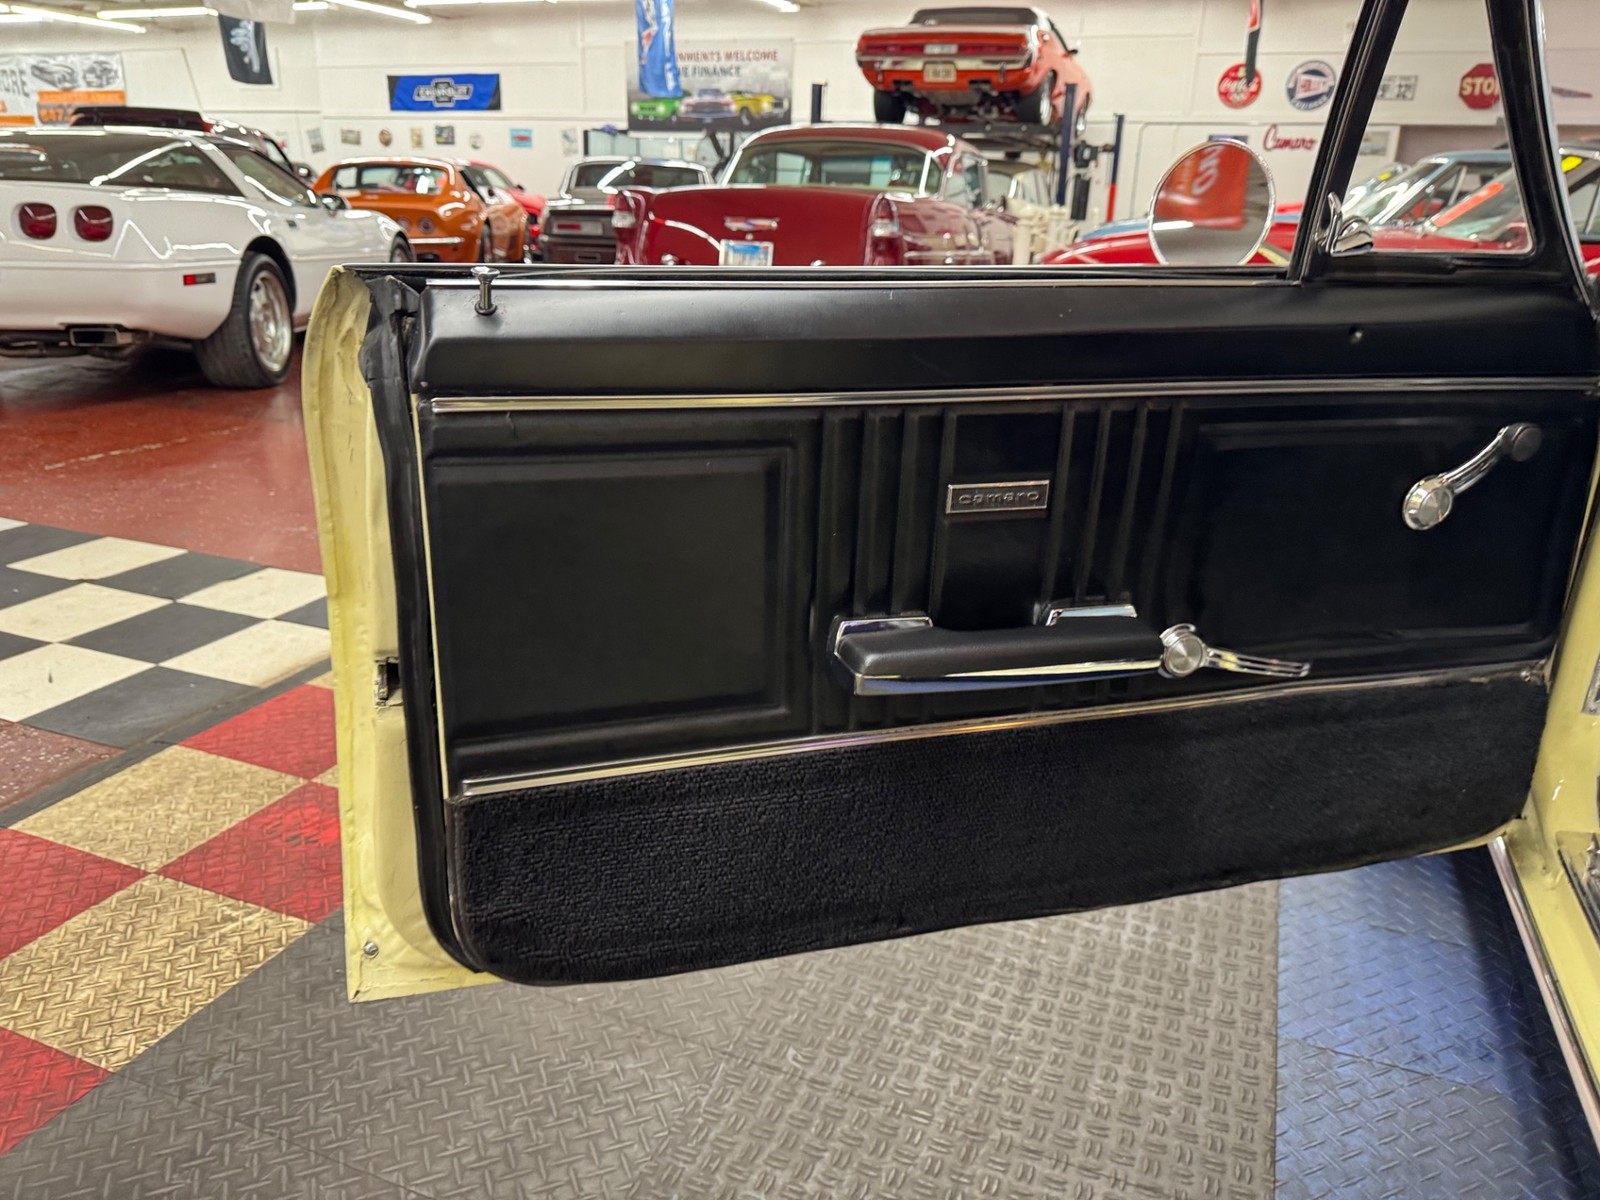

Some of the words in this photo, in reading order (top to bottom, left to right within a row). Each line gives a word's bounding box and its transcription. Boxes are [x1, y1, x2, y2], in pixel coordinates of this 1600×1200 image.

[724, 49, 779, 62] WELCOME
[691, 65, 742, 78] FINANCE
[1461, 77, 1500, 97] STO
[1263, 123, 1318, 152] Camaro
[958, 491, 1040, 505] camaro
